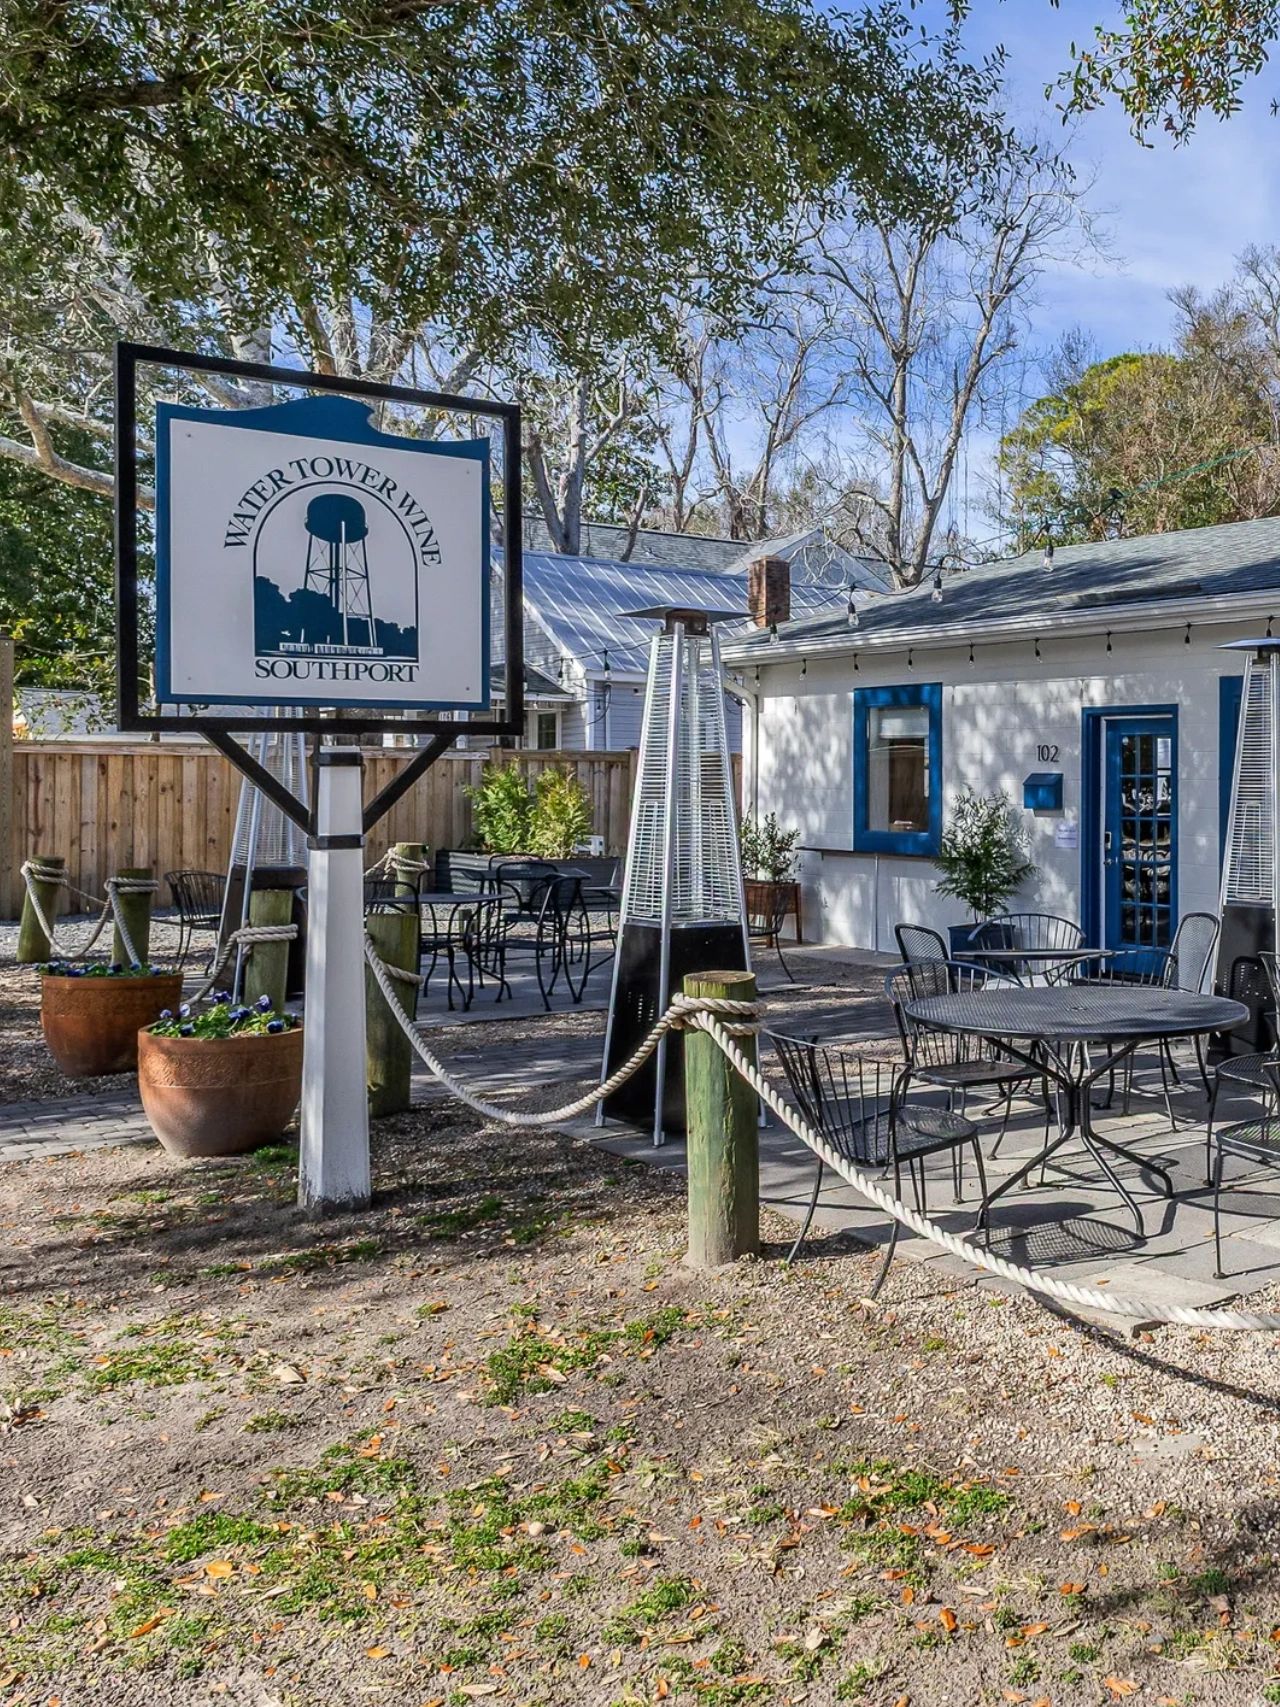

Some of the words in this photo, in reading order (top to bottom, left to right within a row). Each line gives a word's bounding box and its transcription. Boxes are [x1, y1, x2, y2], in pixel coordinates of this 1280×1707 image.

[224, 469, 294, 548] WATER
[289, 456, 397, 500] TOWER
[398, 491, 442, 567] WINE
[254, 658, 420, 683] SOUTHPORT
[1037, 744, 1060, 763] 102
